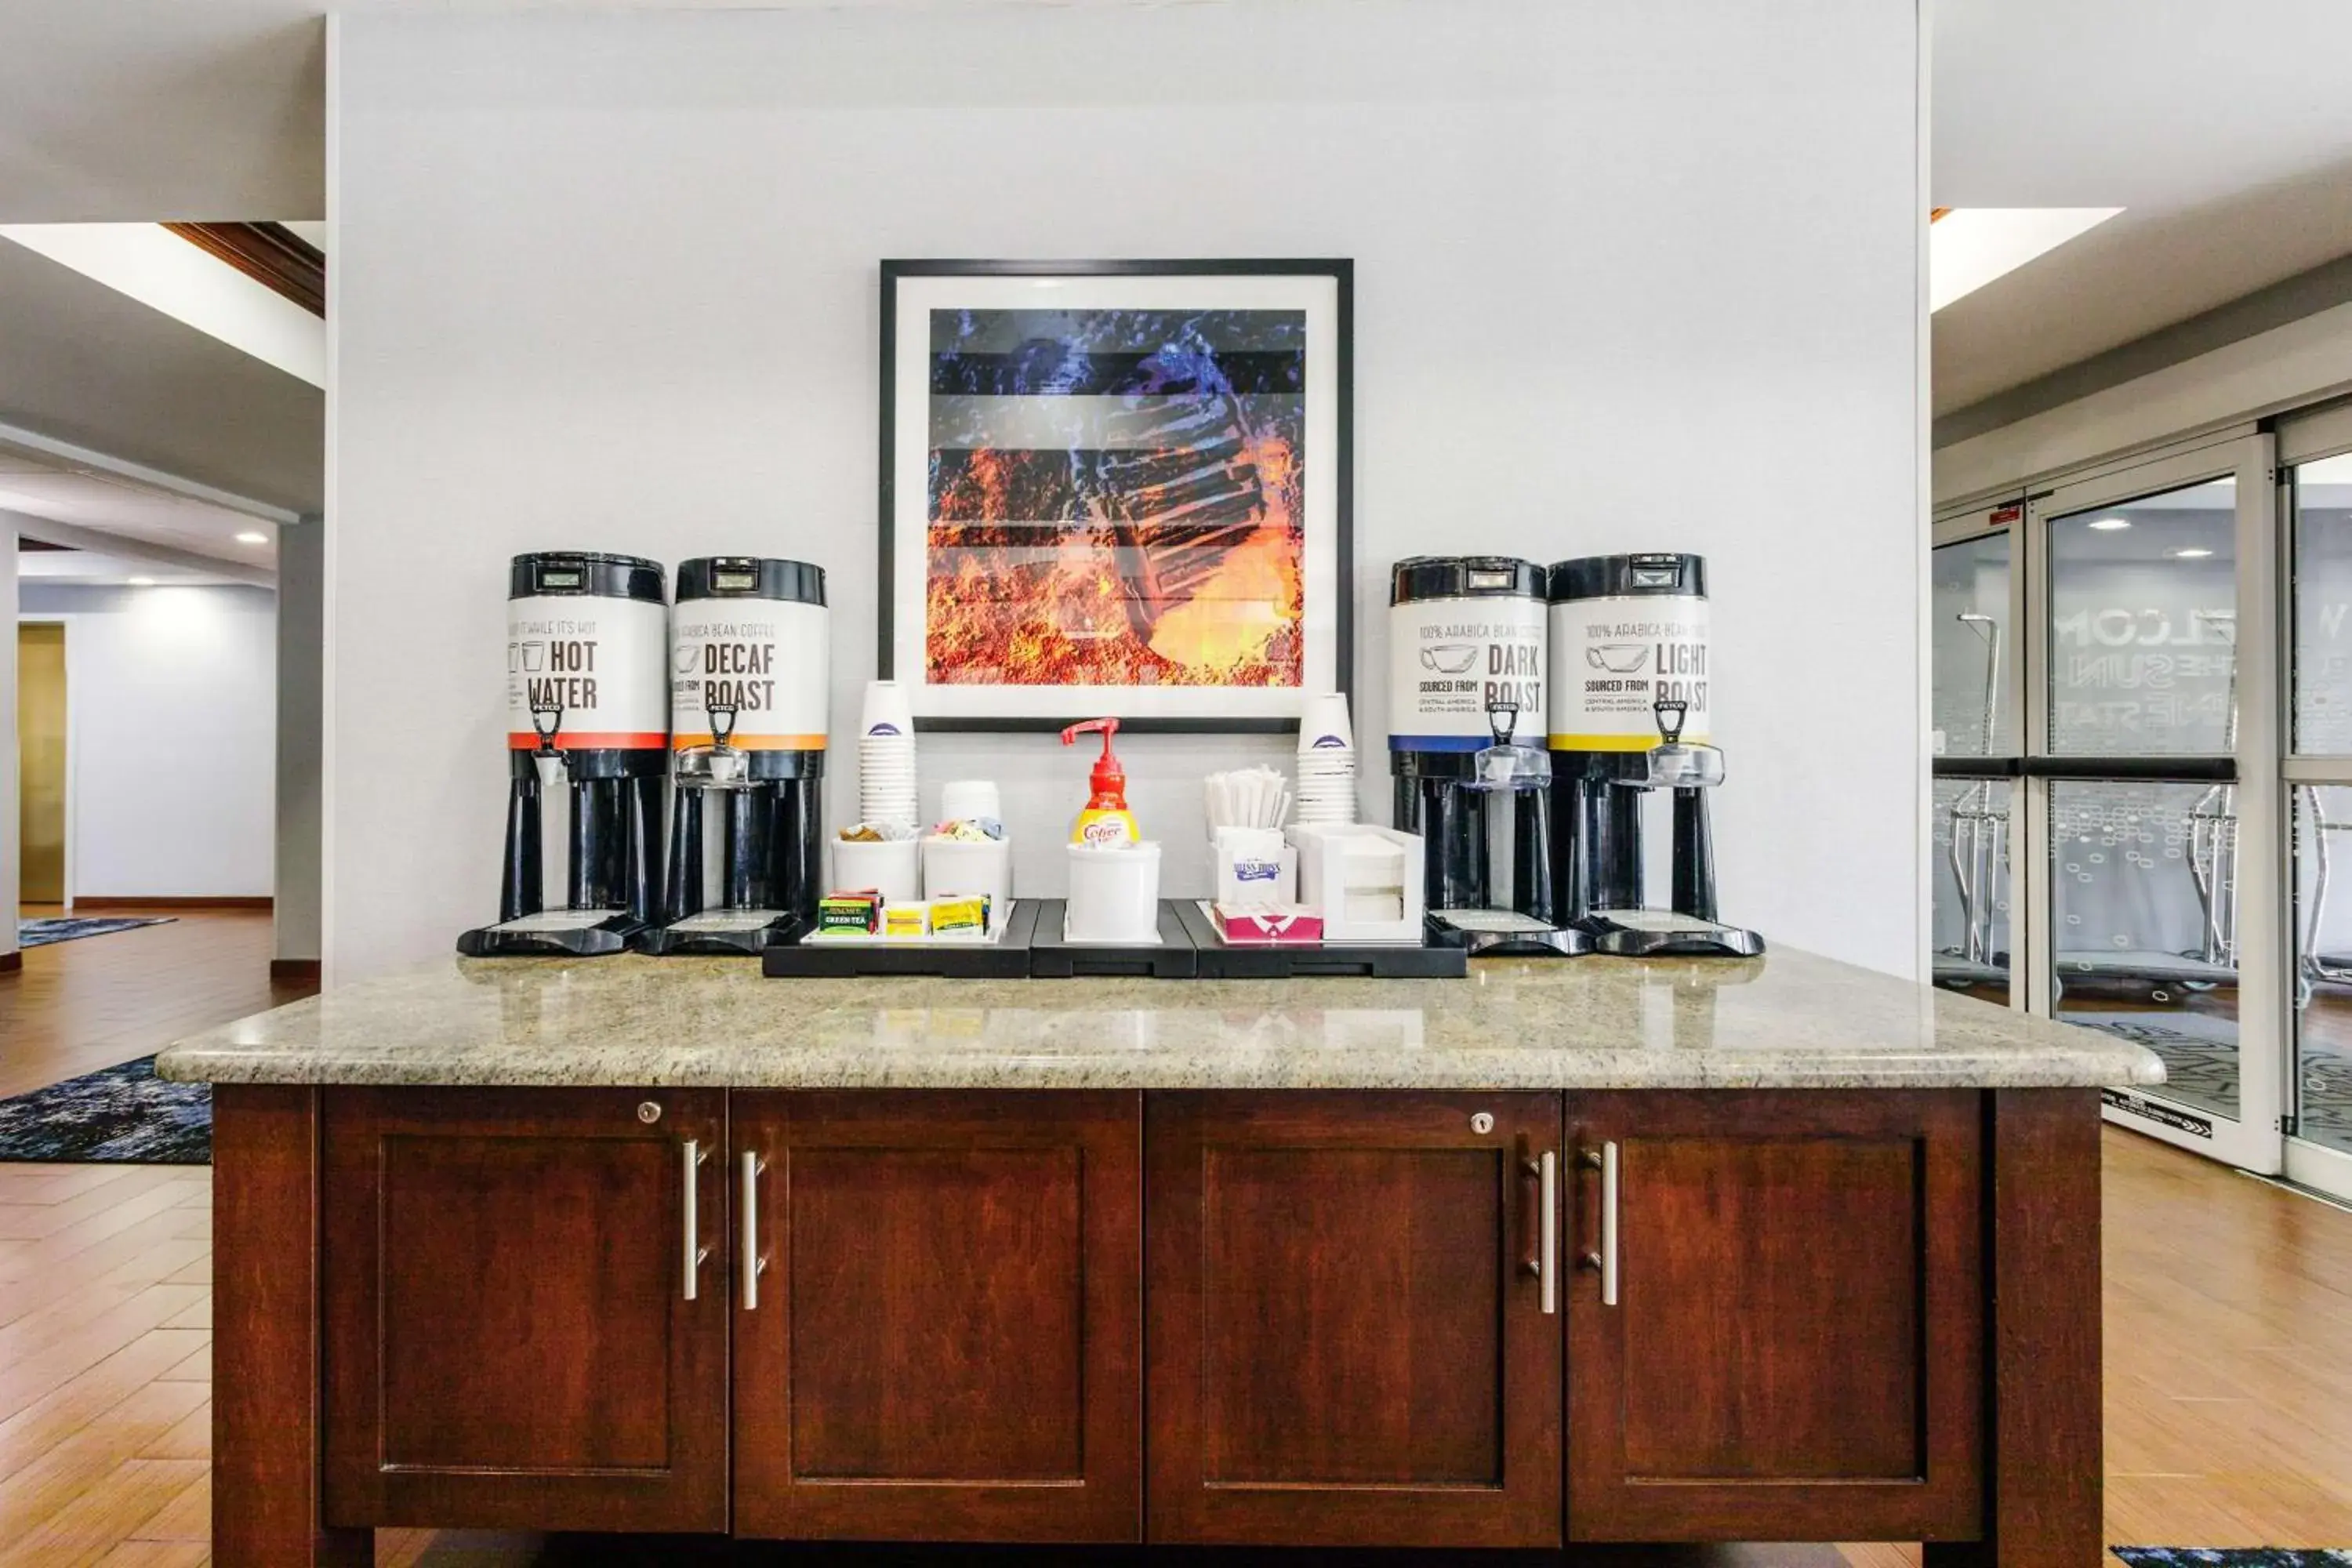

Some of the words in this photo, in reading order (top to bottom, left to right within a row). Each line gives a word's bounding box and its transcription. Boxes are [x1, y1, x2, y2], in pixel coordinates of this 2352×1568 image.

[711, 623, 737, 637] BEAN
[1445, 625, 1490, 639] ARABICA
[1614, 623, 1661, 638] ARABICA
[551, 641, 597, 672] HOT
[705, 644, 775, 674] DECAF
[1489, 644, 1537, 677] DARK
[1656, 643, 1706, 675] LIGHT
[528, 677, 597, 710] WATER
[705, 680, 775, 711] ROAST
[1420, 681, 1453, 692] SOURCED
[1455, 680, 1478, 692] FROM
[1484, 681, 1540, 713] ROAST
[1584, 680, 1621, 692] SOURCED
[1625, 680, 1649, 691] FROM
[1656, 680, 1708, 712] ROAST
[851, 916, 866, 924] TEA
